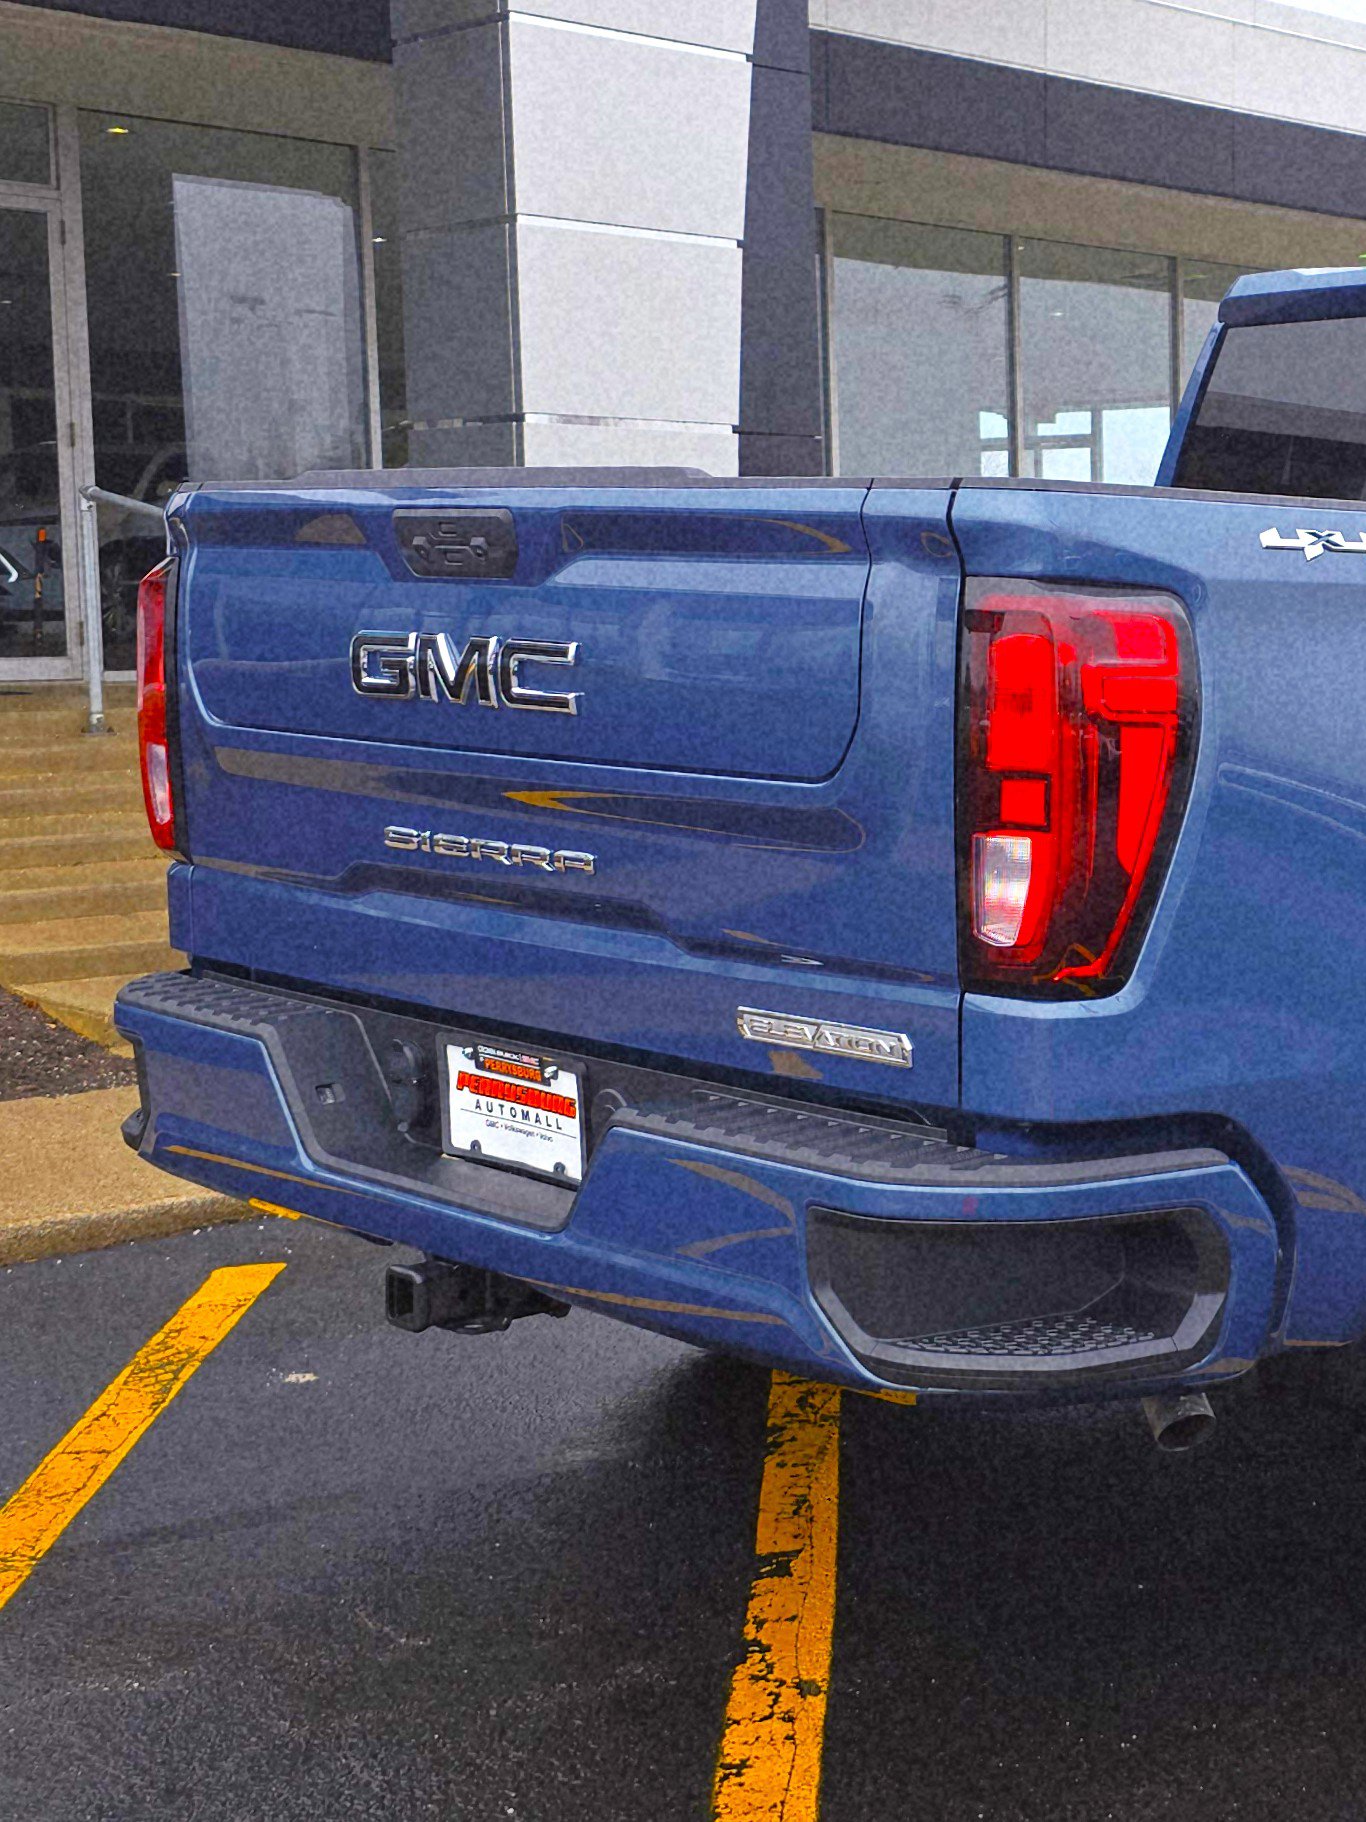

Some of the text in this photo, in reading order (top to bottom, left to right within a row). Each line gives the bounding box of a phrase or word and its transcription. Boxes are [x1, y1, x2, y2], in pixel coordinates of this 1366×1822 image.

[350, 630, 584, 716] GMC
[384, 825, 598, 876] SIERRA
[748, 1016, 900, 1056] ELEVATION
[484, 1057, 542, 1082] PERRYSBURG
[456, 1070, 577, 1119] PERRYSBURG
[475, 1099, 562, 1130] AUTOMALL
